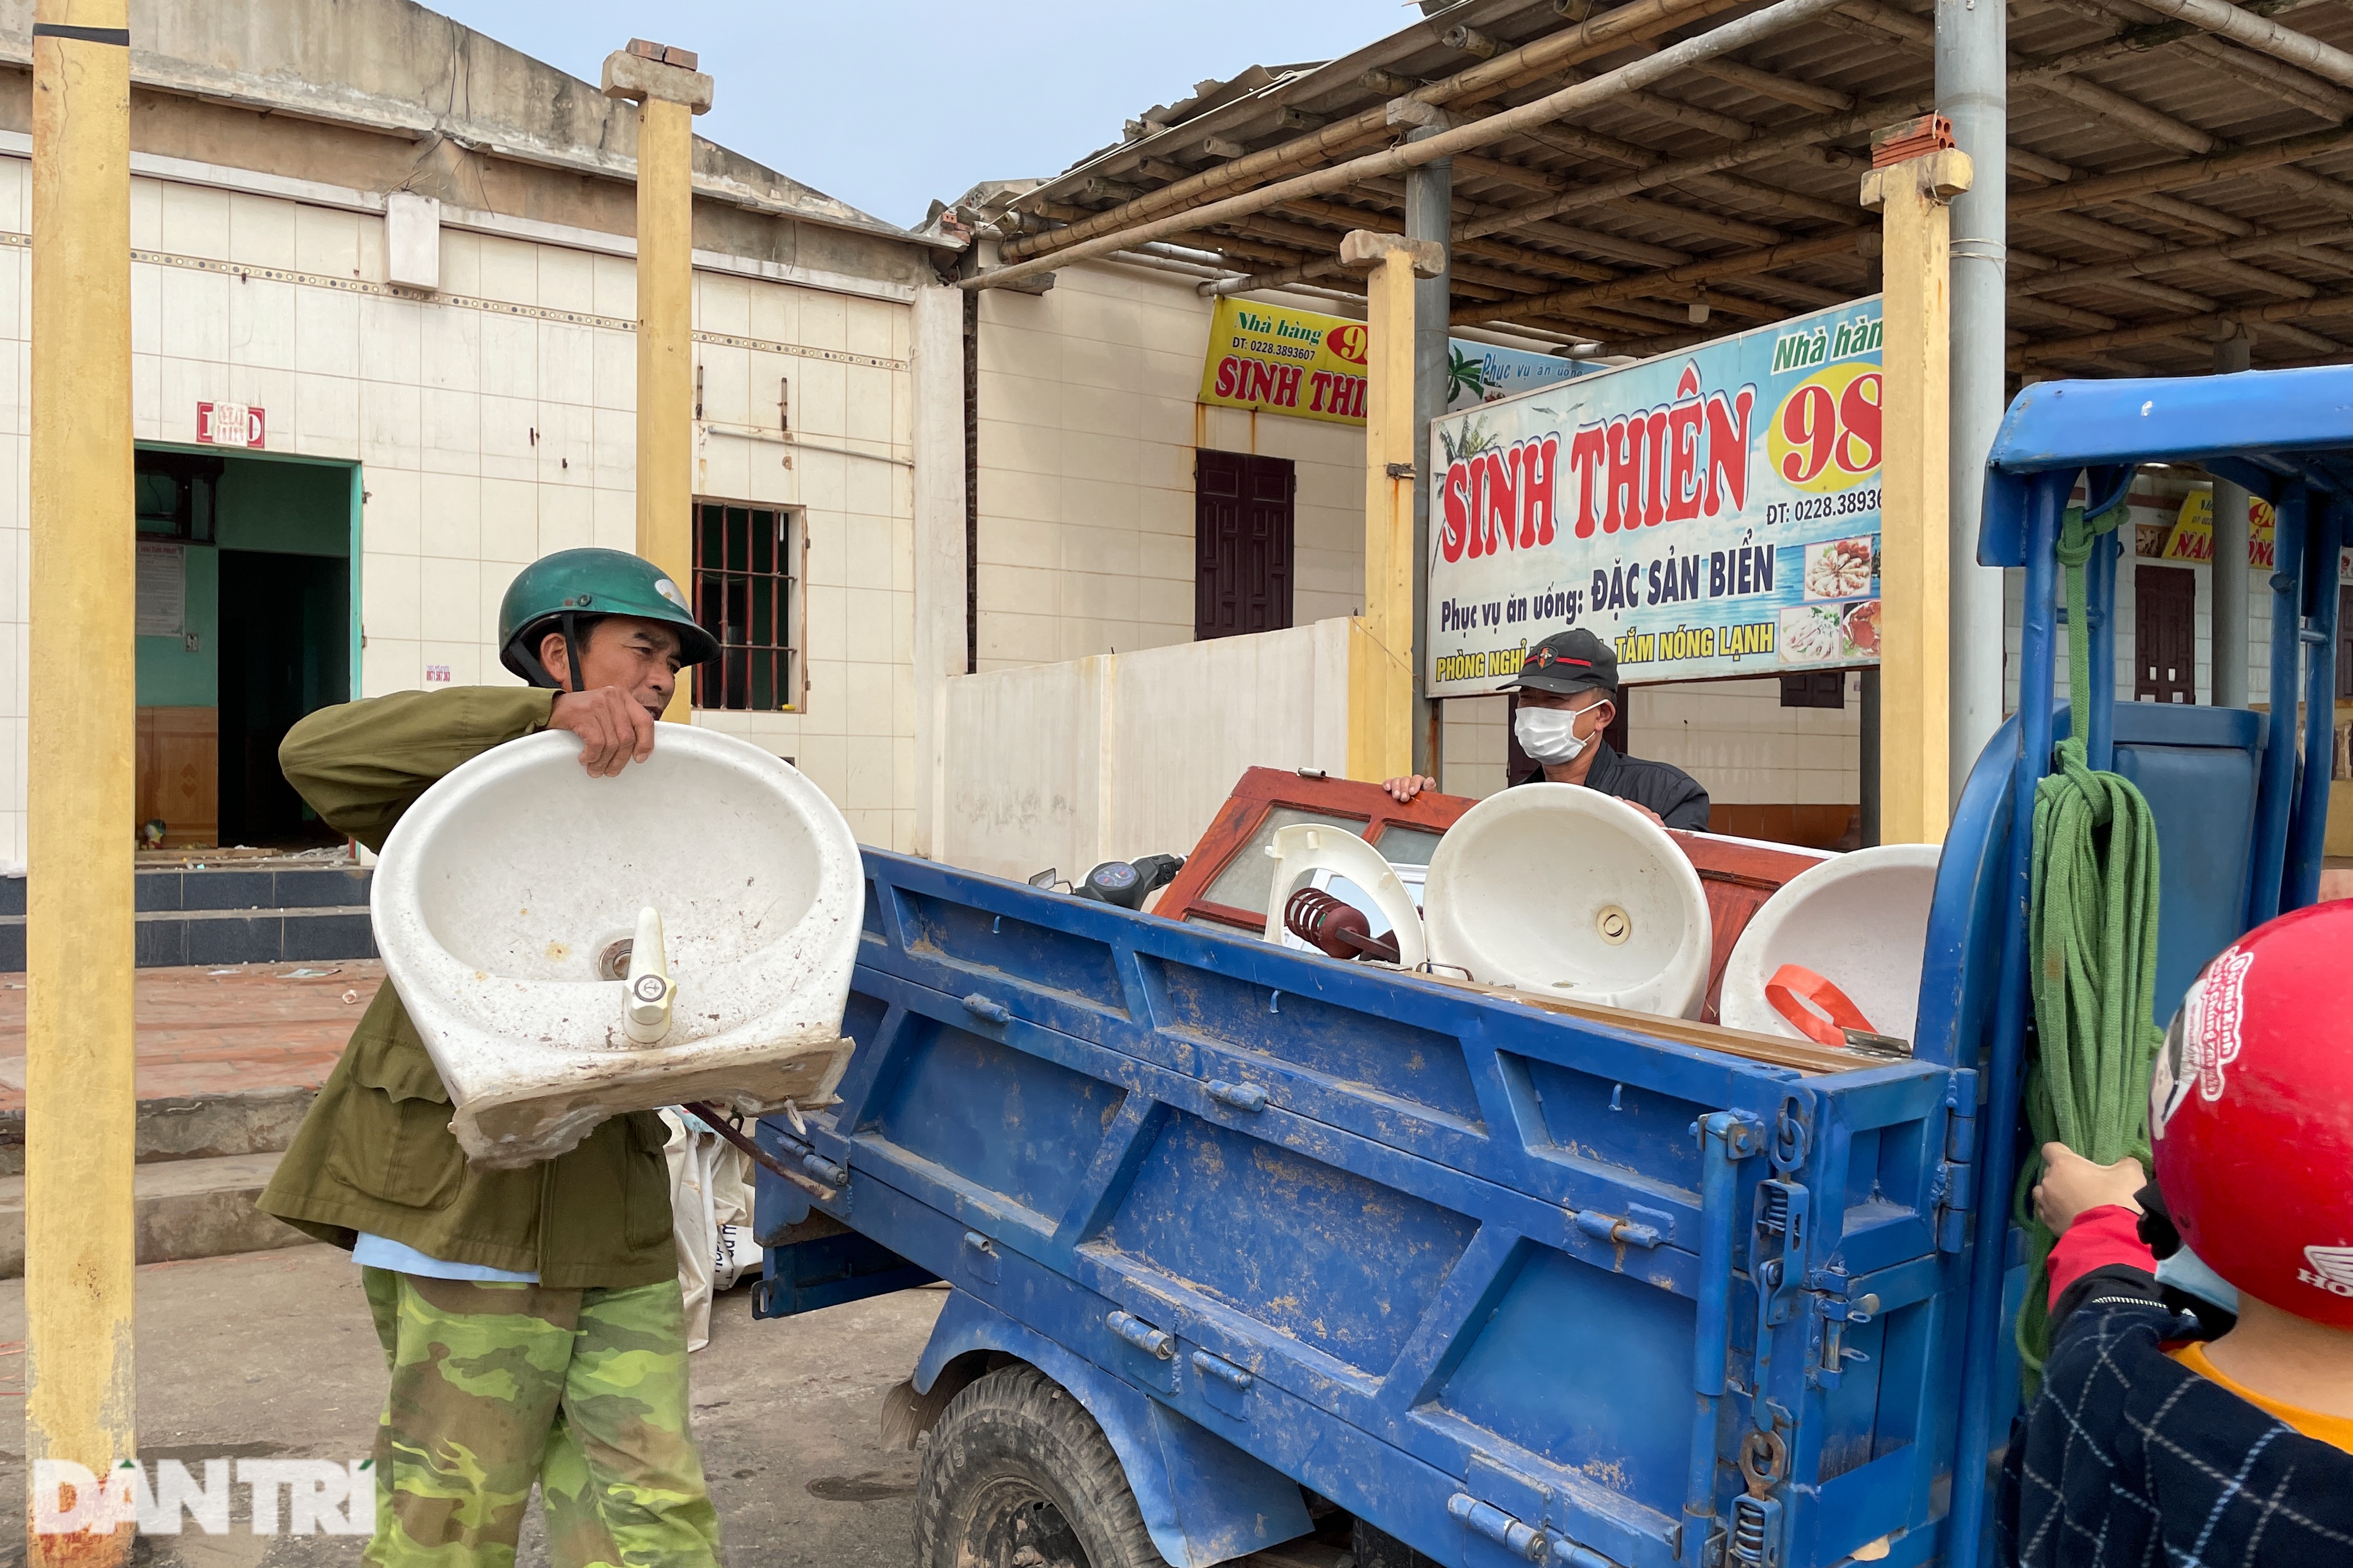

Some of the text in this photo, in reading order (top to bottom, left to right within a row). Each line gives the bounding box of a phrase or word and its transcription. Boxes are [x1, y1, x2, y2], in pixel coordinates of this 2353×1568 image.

[1235, 312, 1323, 346] Nhà hàng
[1251, 341, 1315, 360] 0228.3893607
[1341, 326, 1367, 360] 9
[1771, 316, 1882, 374] Nhà hàn
[1215, 355, 1367, 418] SINH THI
[1480, 353, 1510, 386] Phục
[1517, 363, 1530, 380] vụ
[1538, 363, 1550, 376] ăn
[1783, 373, 1882, 483] 98
[1442, 358, 1757, 563] SINH THIÊN
[1767, 503, 1789, 525] ĐT:
[1441, 528, 1774, 638] Phục vụ ăn uống: ĐẶC SẢN BIỂN
[1436, 649, 1485, 683] PHÒNG
[1615, 626, 1655, 664] TẮM
[1659, 624, 1715, 661] NÓNG
[1719, 622, 1775, 662] LẠNH
[2296, 1268, 2353, 1298] HO
